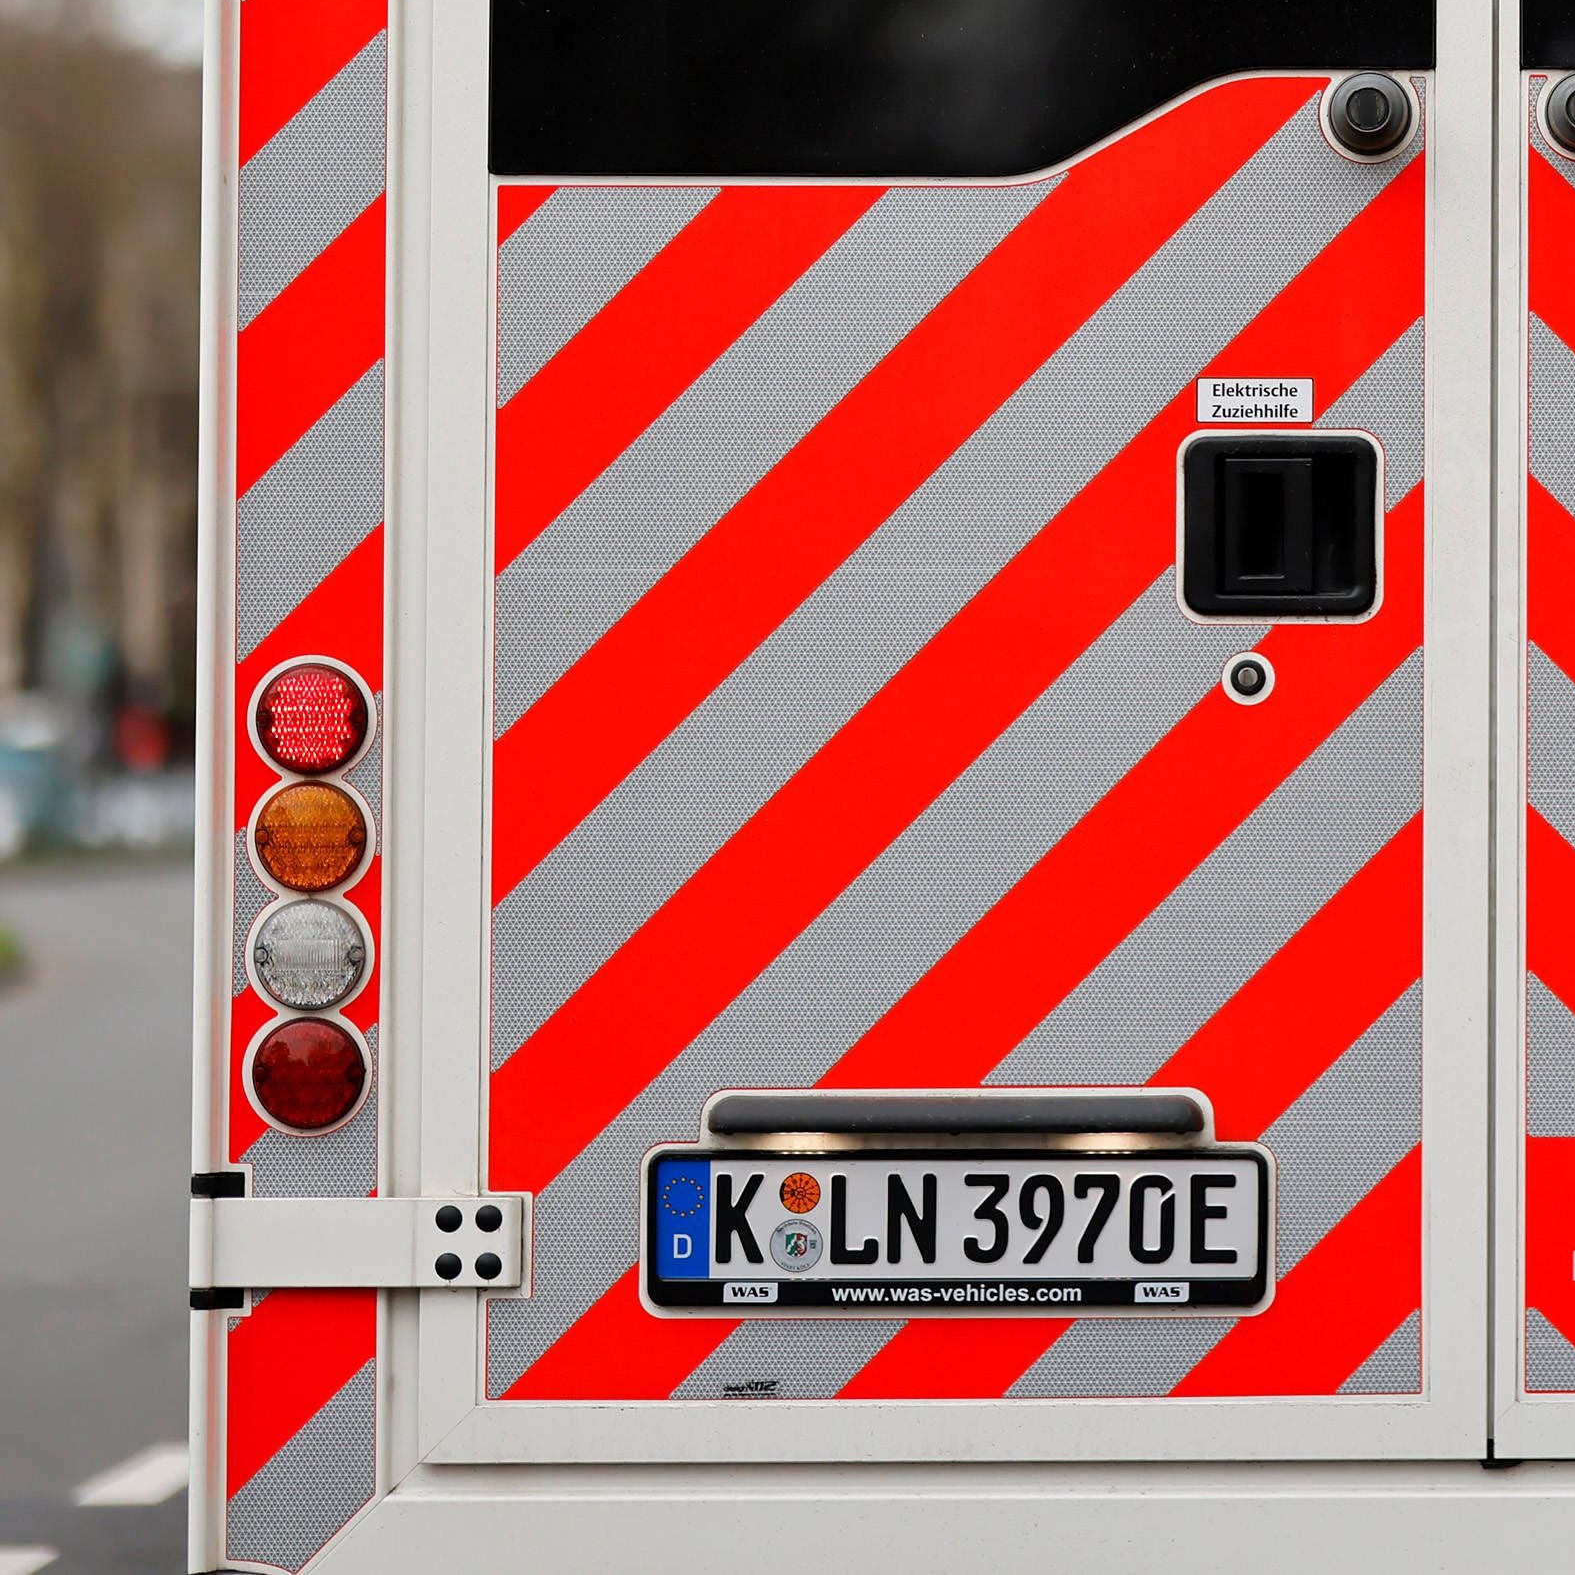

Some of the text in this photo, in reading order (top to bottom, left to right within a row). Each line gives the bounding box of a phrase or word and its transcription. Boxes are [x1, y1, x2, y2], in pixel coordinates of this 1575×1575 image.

[1213, 383, 1297, 396] Elektrische
[1212, 404, 1297, 417] Zuziehhilfe
[716, 1175, 764, 1263] K
[674, 1234, 691, 1258] D
[732, 1287, 768, 1297] WAS
[832, 1284, 1081, 1301] www.was-vehicles.com
[1143, 1287, 1179, 1297] WAS
